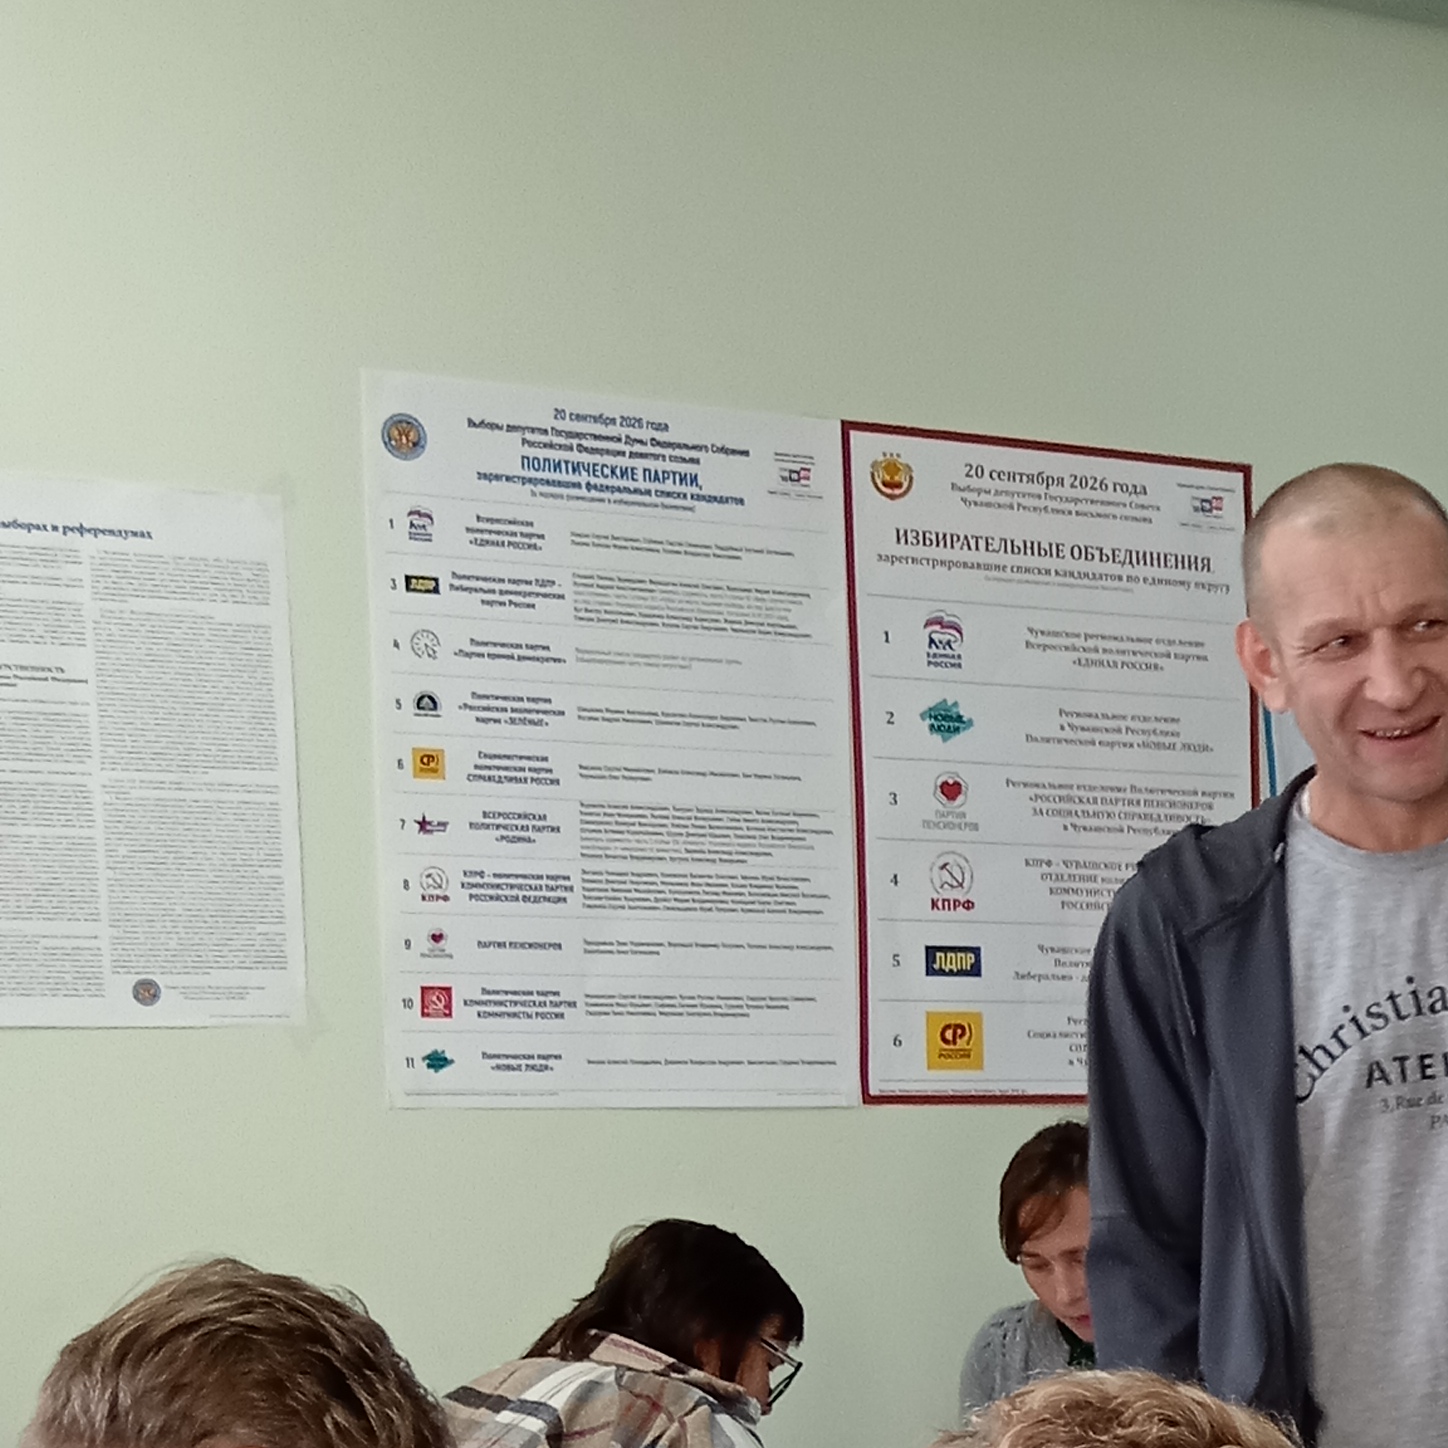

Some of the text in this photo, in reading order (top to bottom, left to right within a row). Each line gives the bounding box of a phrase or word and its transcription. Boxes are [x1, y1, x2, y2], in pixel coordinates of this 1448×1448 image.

[521, 455, 703, 491] ПОЛИТИЧЕСКИЕ ПАРТИИ,
[964, 463, 1148, 498] 20 сентября 2026 года
[0, 518, 49, 534] ыборах
[62, 522, 153, 541] референдумах
[895, 527, 1066, 560] ИЗБИРАТЕЛЬНЫЕ
[877, 552, 1007, 574] зарегистрировавшие
[1010, 563, 1051, 578] списки
[1054, 566, 1123, 583] кандидатов
[1143, 574, 1191, 591] единому
[883, 630, 890, 644] 1
[886, 710, 895, 725] 2
[889, 792, 898, 806] 3
[890, 873, 899, 887] 4
[930, 897, 976, 912] КПРФ
[892, 951, 976, 973] 5 ЛДПР
[892, 1033, 902, 1048] 6
